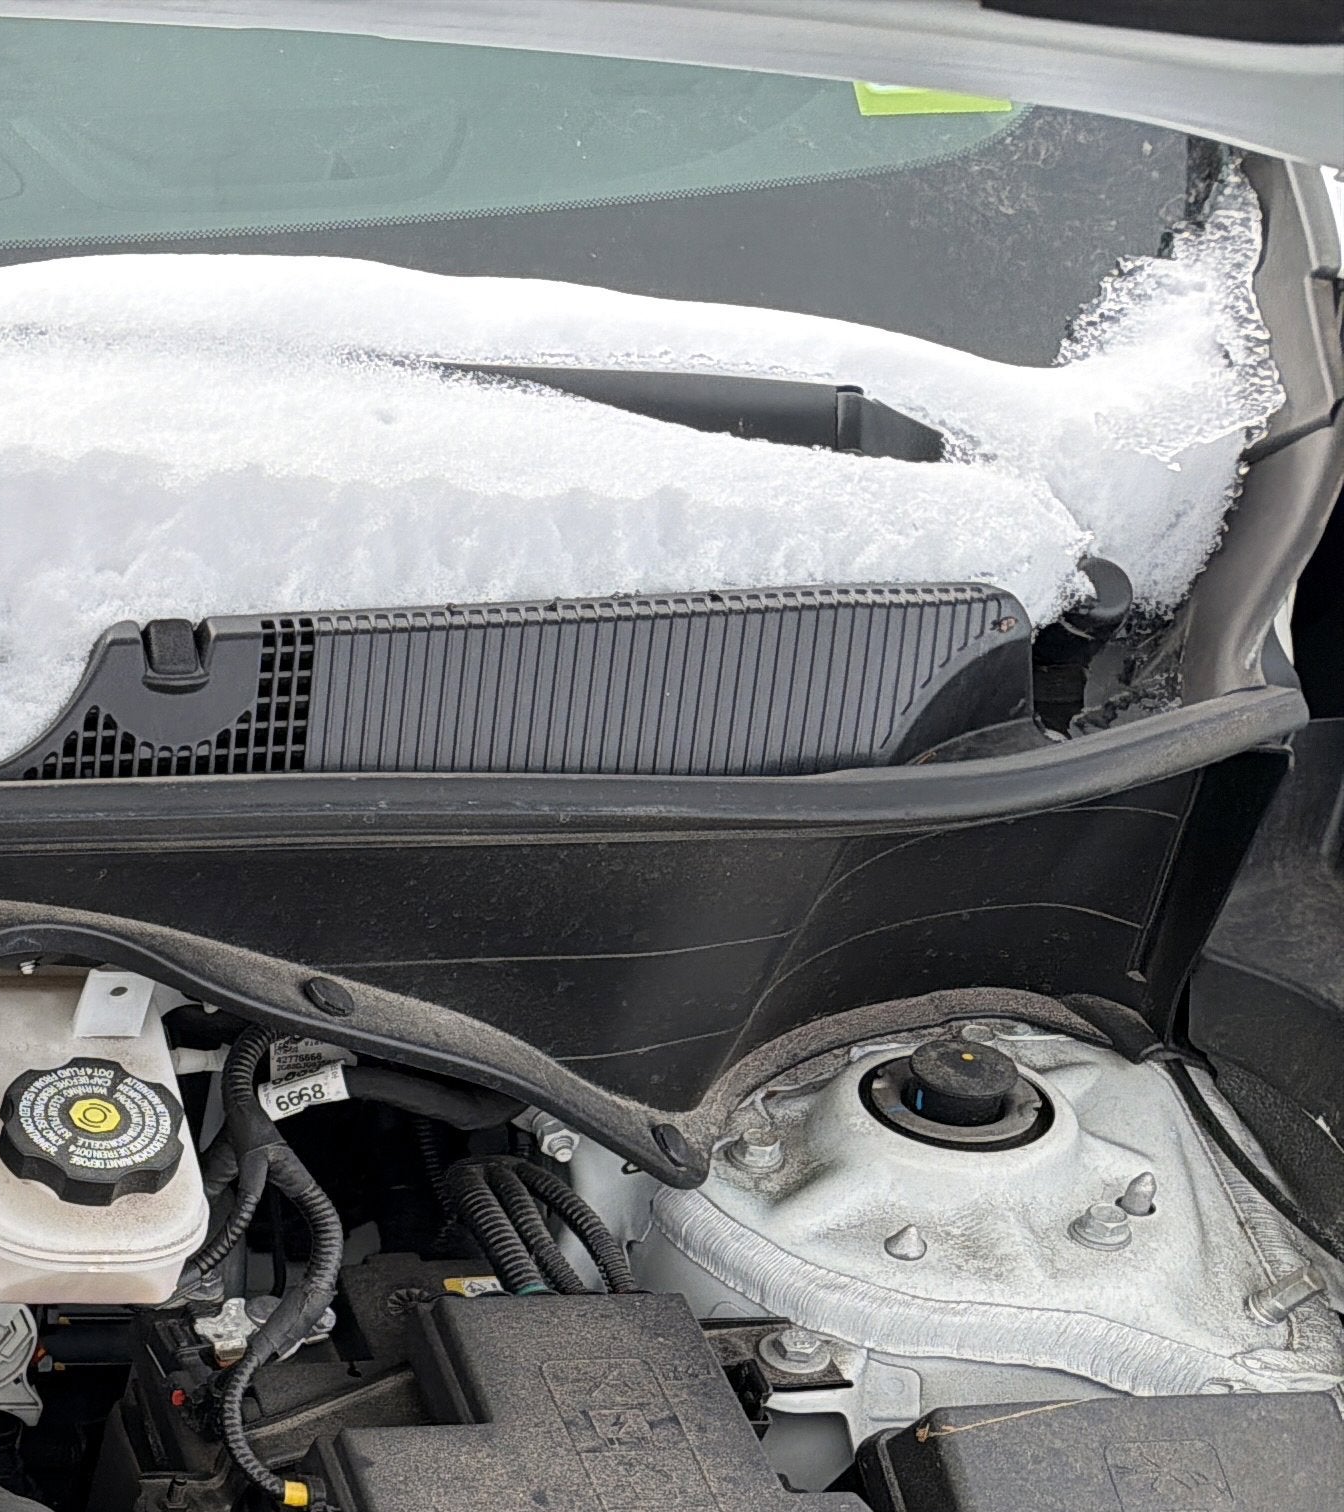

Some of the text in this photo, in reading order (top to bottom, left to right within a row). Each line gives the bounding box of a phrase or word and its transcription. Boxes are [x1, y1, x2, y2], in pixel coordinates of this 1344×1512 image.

[56, 1067, 85, 1078] FLUID
[85, 1067, 92, 1075] 4
[92, 1067, 114, 1079] DOT
[32, 1072, 59, 1089] FROM
[52, 1075, 90, 1090] BEFORE
[89, 1077, 112, 1087] CAP
[122, 1077, 162, 1105] ATTENTION
[275, 1083, 326, 1112] 6668
[18, 1091, 36, 1117] SEALED
